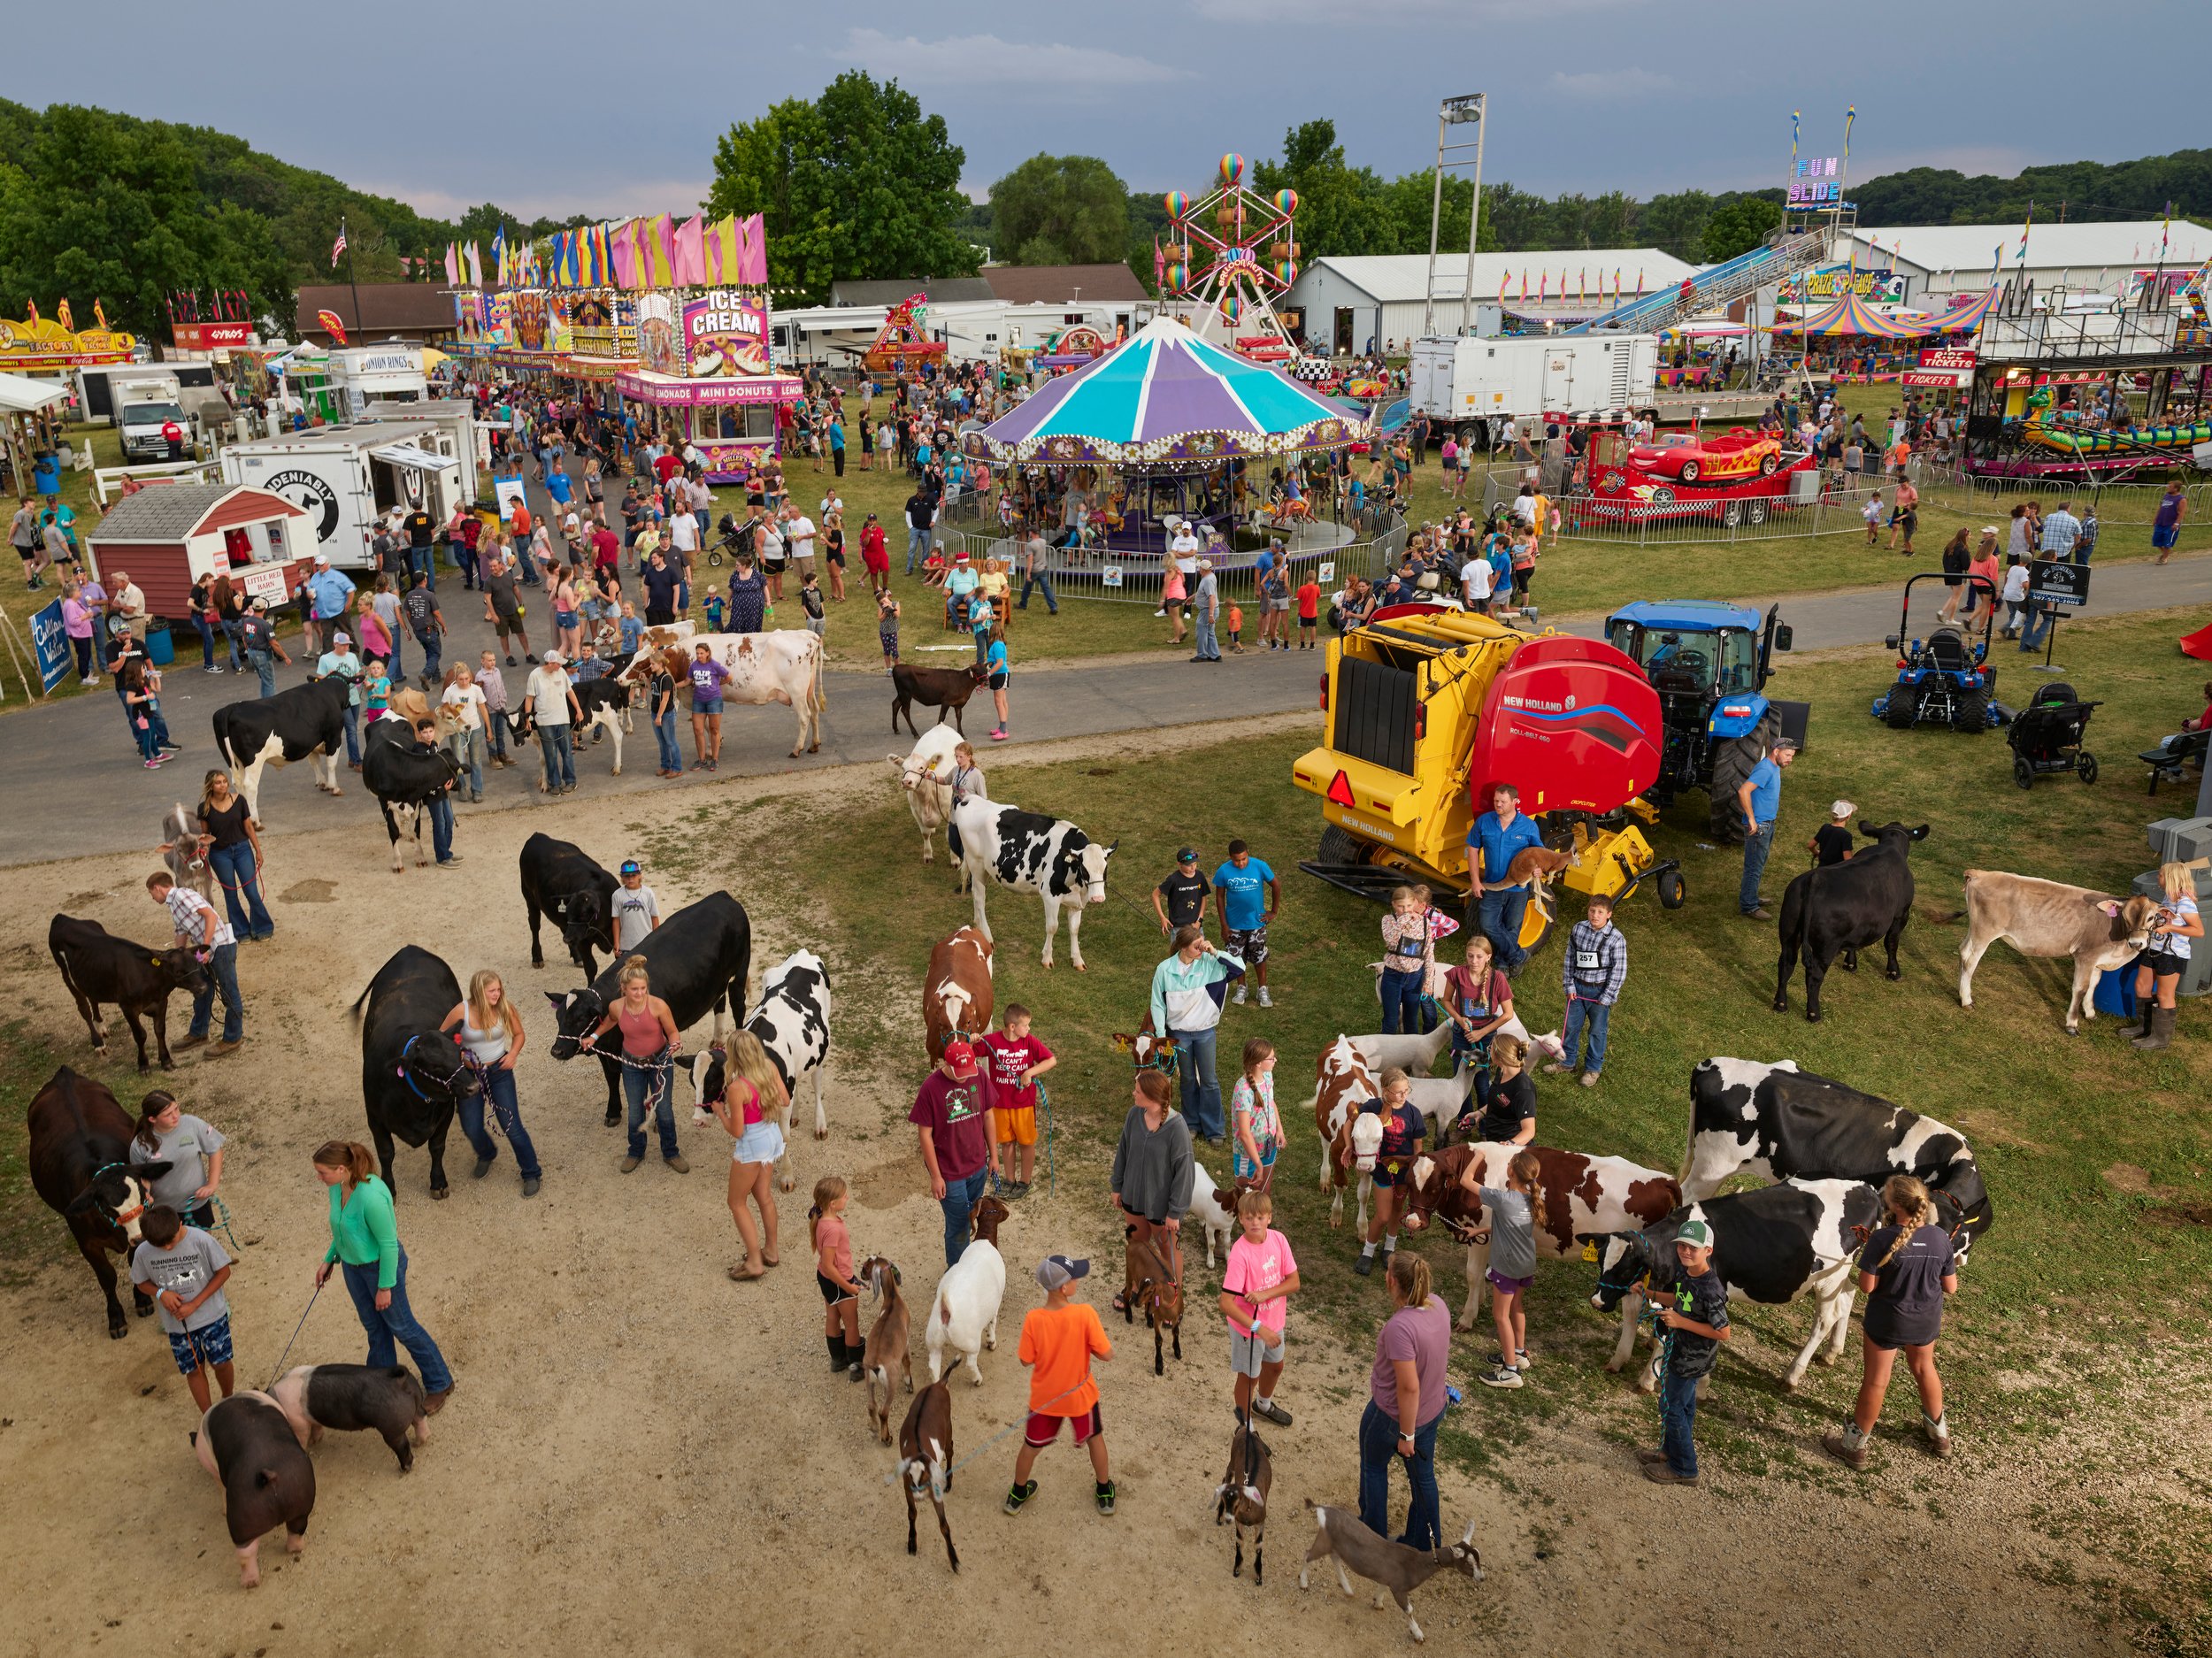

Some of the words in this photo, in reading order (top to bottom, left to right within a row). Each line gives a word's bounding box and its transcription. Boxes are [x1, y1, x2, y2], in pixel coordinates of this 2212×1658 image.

[1797, 157, 1838, 177] FUN
[1790, 181, 1840, 201] SLIDE
[1218, 259, 1246, 287] BALLOON
[1247, 261, 1264, 287] FIESTA
[1808, 273, 1833, 295] PRIZE
[1844, 272, 1873, 294] PLACE
[707, 291, 741, 311] ICE
[692, 311, 761, 336] CREAM
[211, 328, 243, 340] GYROS
[28, 341, 73, 352] FACTORY
[574, 338, 594, 354] CHEESE
[594, 339, 613, 356] CURDS
[366, 357, 386, 369] ONION
[388, 356, 408, 368] RINGS
[521, 354, 531, 365] DOGS
[1924, 358, 1973, 368] TICKETS
[1909, 374, 1952, 385] TICKETS
[700, 389, 725, 398] MINI
[728, 387, 773, 397] DONUTS
[1704, 453, 1720, 475] 59
[417, 517, 426, 526] CAT
[247, 574, 267, 585] LITTLE
[257, 580, 275, 590] BARN
[2032, 595, 2079, 605] 507-545-2000
[35, 618, 65, 646] Culligan
[1504, 695, 1524, 707] NEW
[1525, 698, 1562, 711] HOLLAND
[1509, 727, 1538, 740] ROLL-BELT
[1539, 734, 1550, 743] 460
[1571, 799, 1596, 808] CROPCUTTER
[1341, 814, 1359, 828] NEW
[1360, 822, 1394, 841] HOLLAND
[150, 1257, 178, 1266] RUNNING
